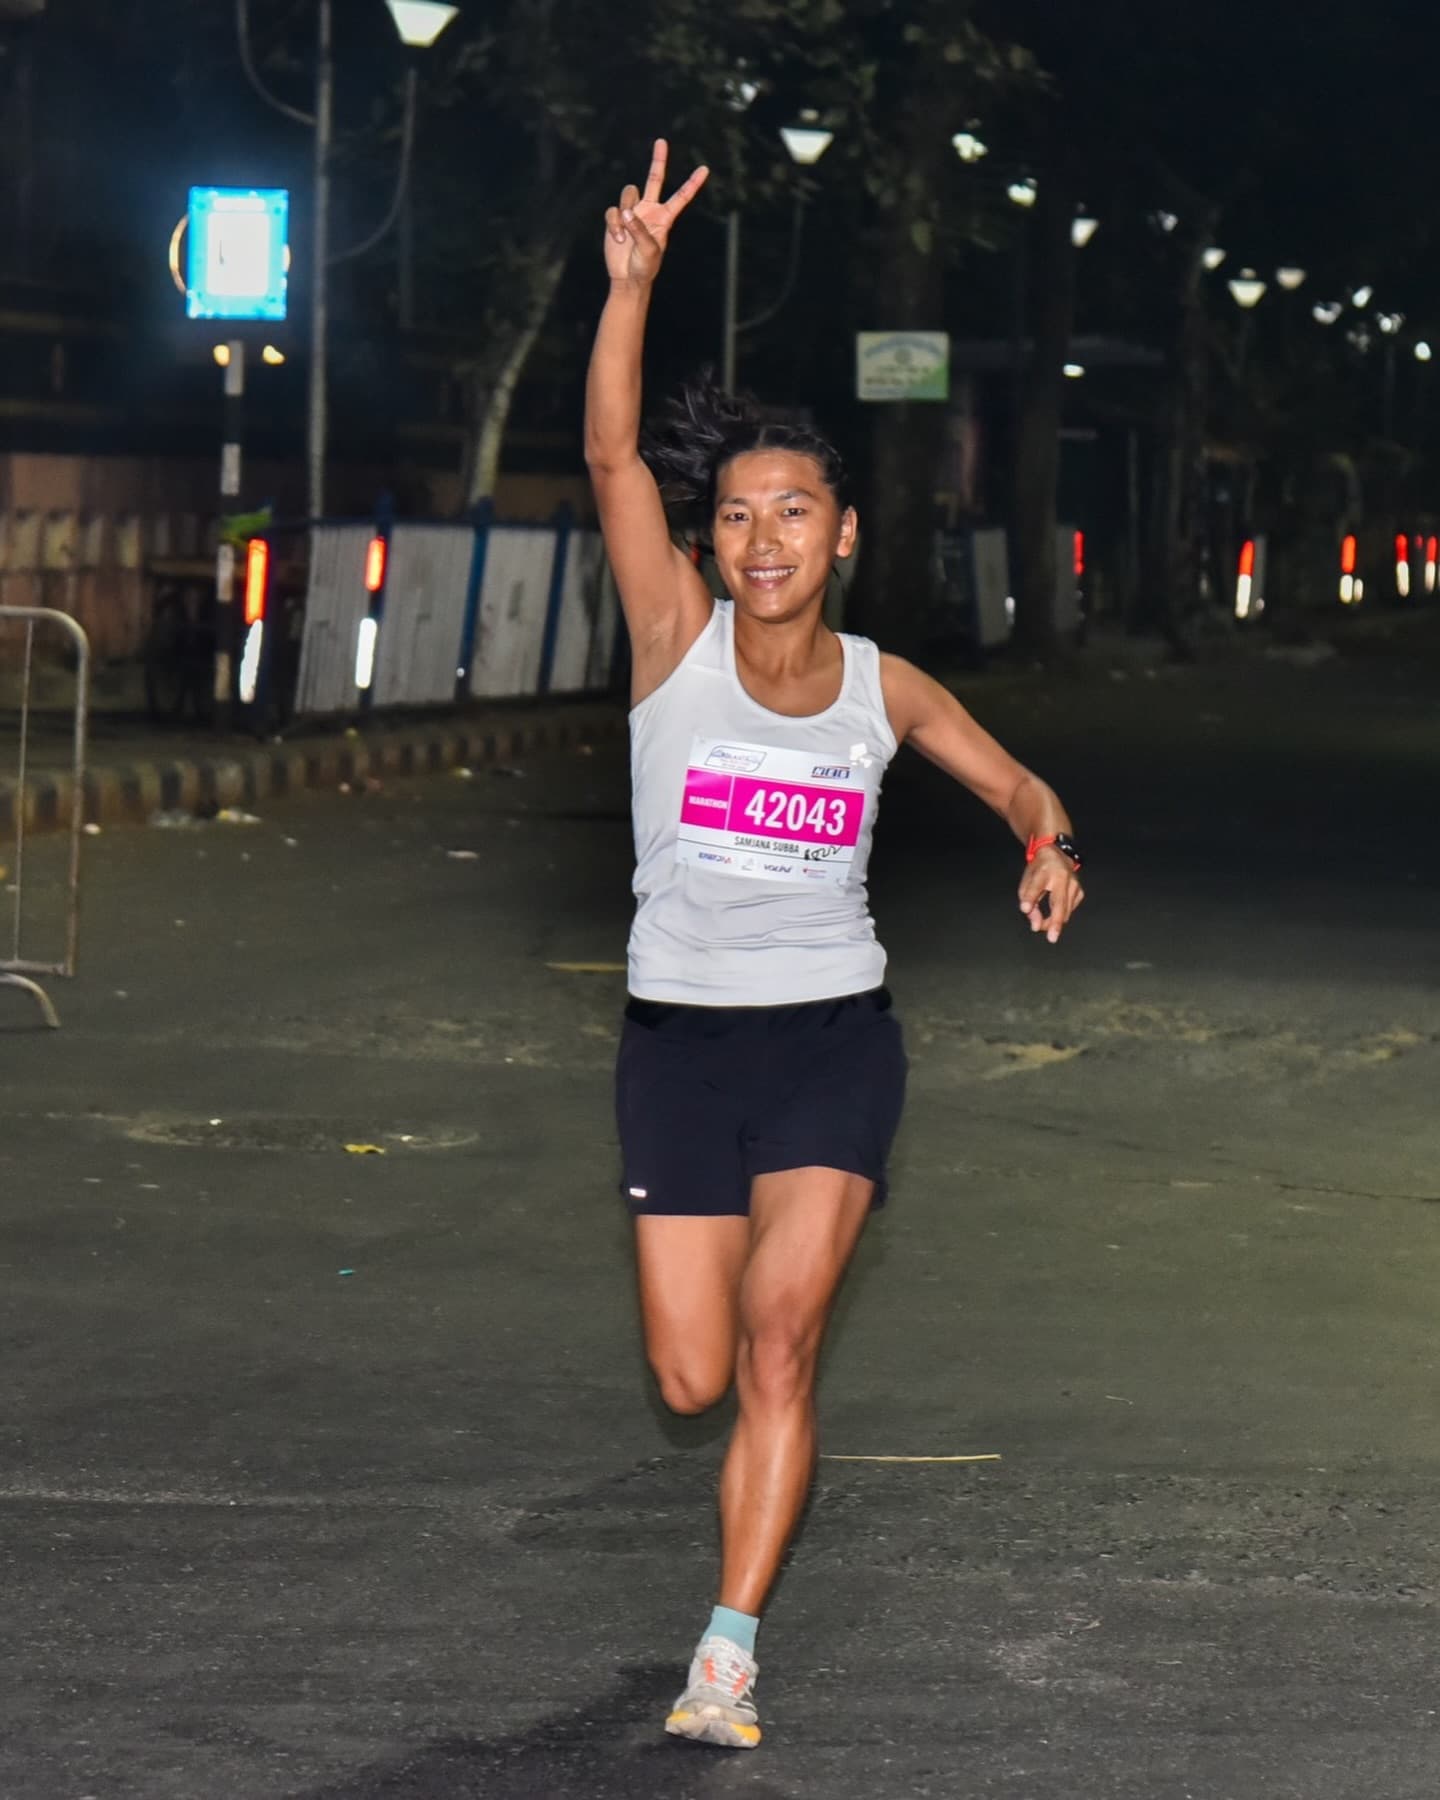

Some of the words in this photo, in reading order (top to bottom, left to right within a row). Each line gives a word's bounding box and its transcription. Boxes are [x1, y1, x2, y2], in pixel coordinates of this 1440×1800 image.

[744, 789, 847, 836] 42043
[734, 836, 771, 851] SAMJANA
[773, 841, 800, 854] SUBBA
